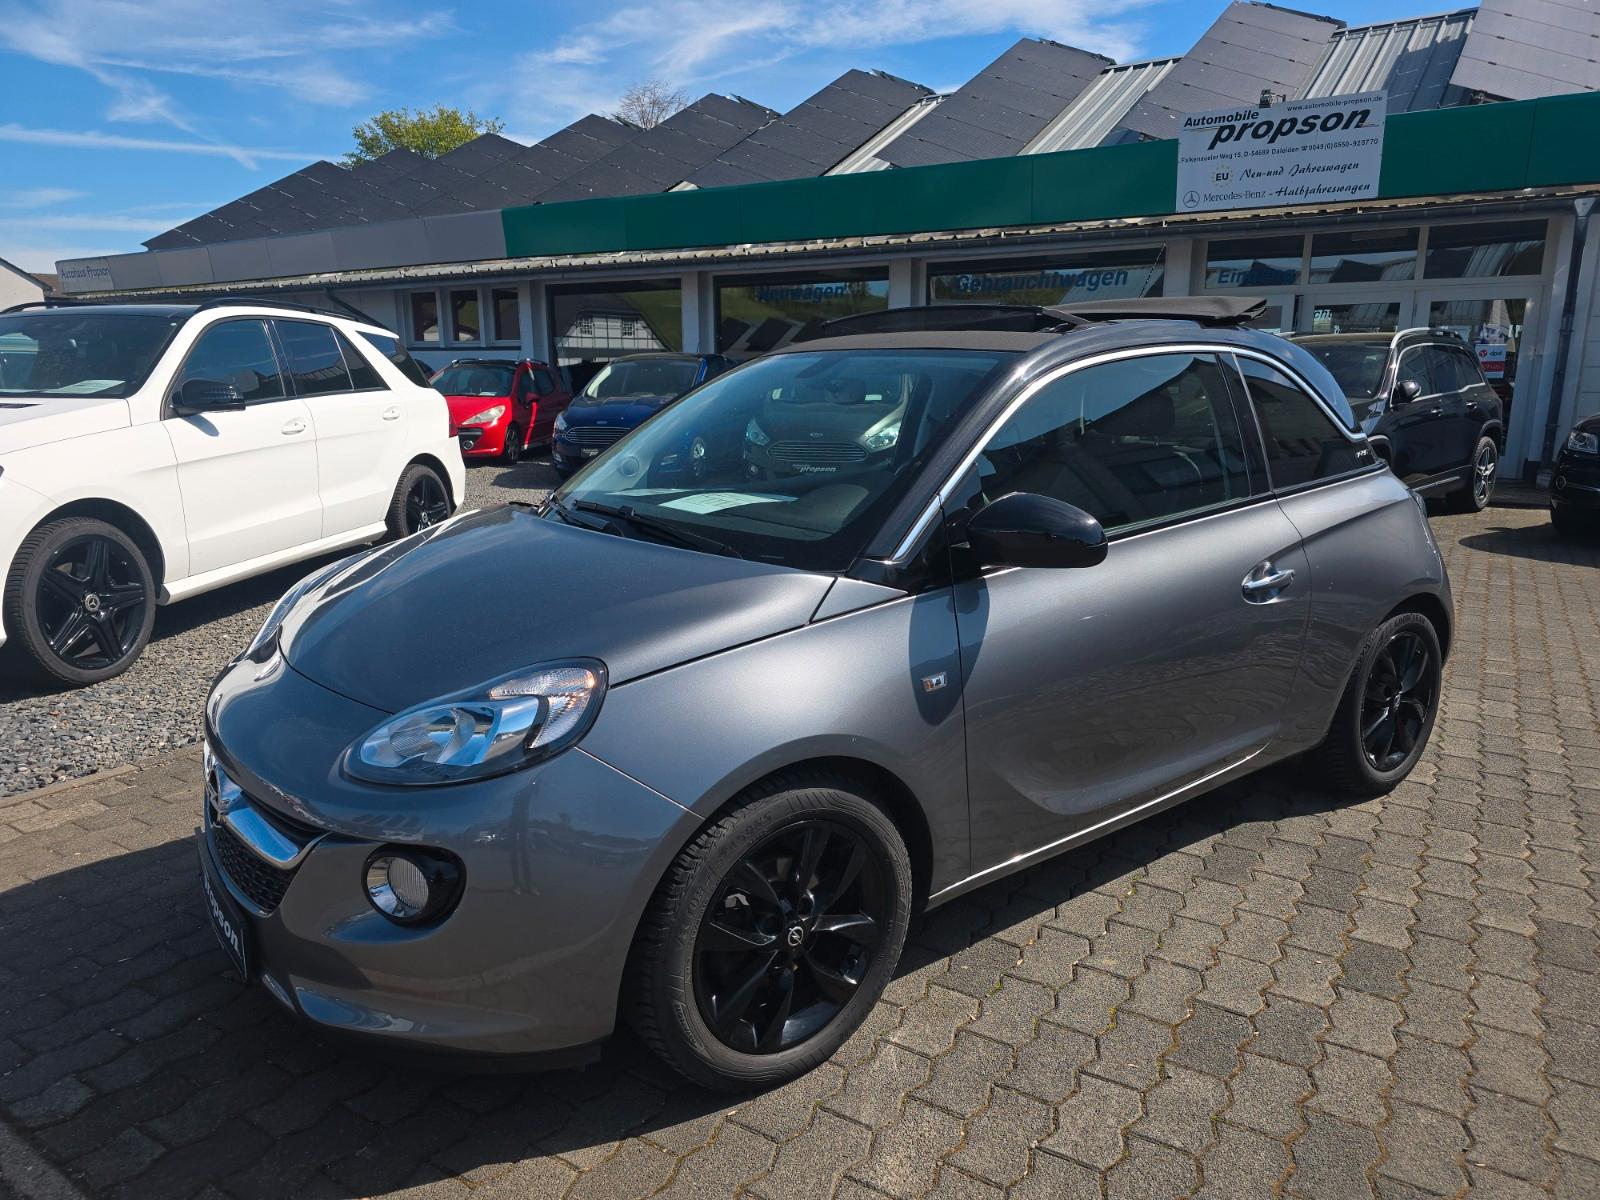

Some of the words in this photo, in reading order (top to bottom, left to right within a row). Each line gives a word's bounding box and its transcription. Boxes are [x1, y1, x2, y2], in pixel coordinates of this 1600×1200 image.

[1184, 110, 1259, 127] Automobile
[1208, 108, 1370, 150] propson
[1220, 152, 1232, 160] Weg
[1215, 172, 1229, 181] EU
[1289, 163, 1359, 176] Jahreswagen
[1204, 190, 1265, 202] Mercedes-Benz
[1275, 183, 1370, 198] Halbjahreswagen
[957, 269, 1128, 292] Gebrauchtwagen
